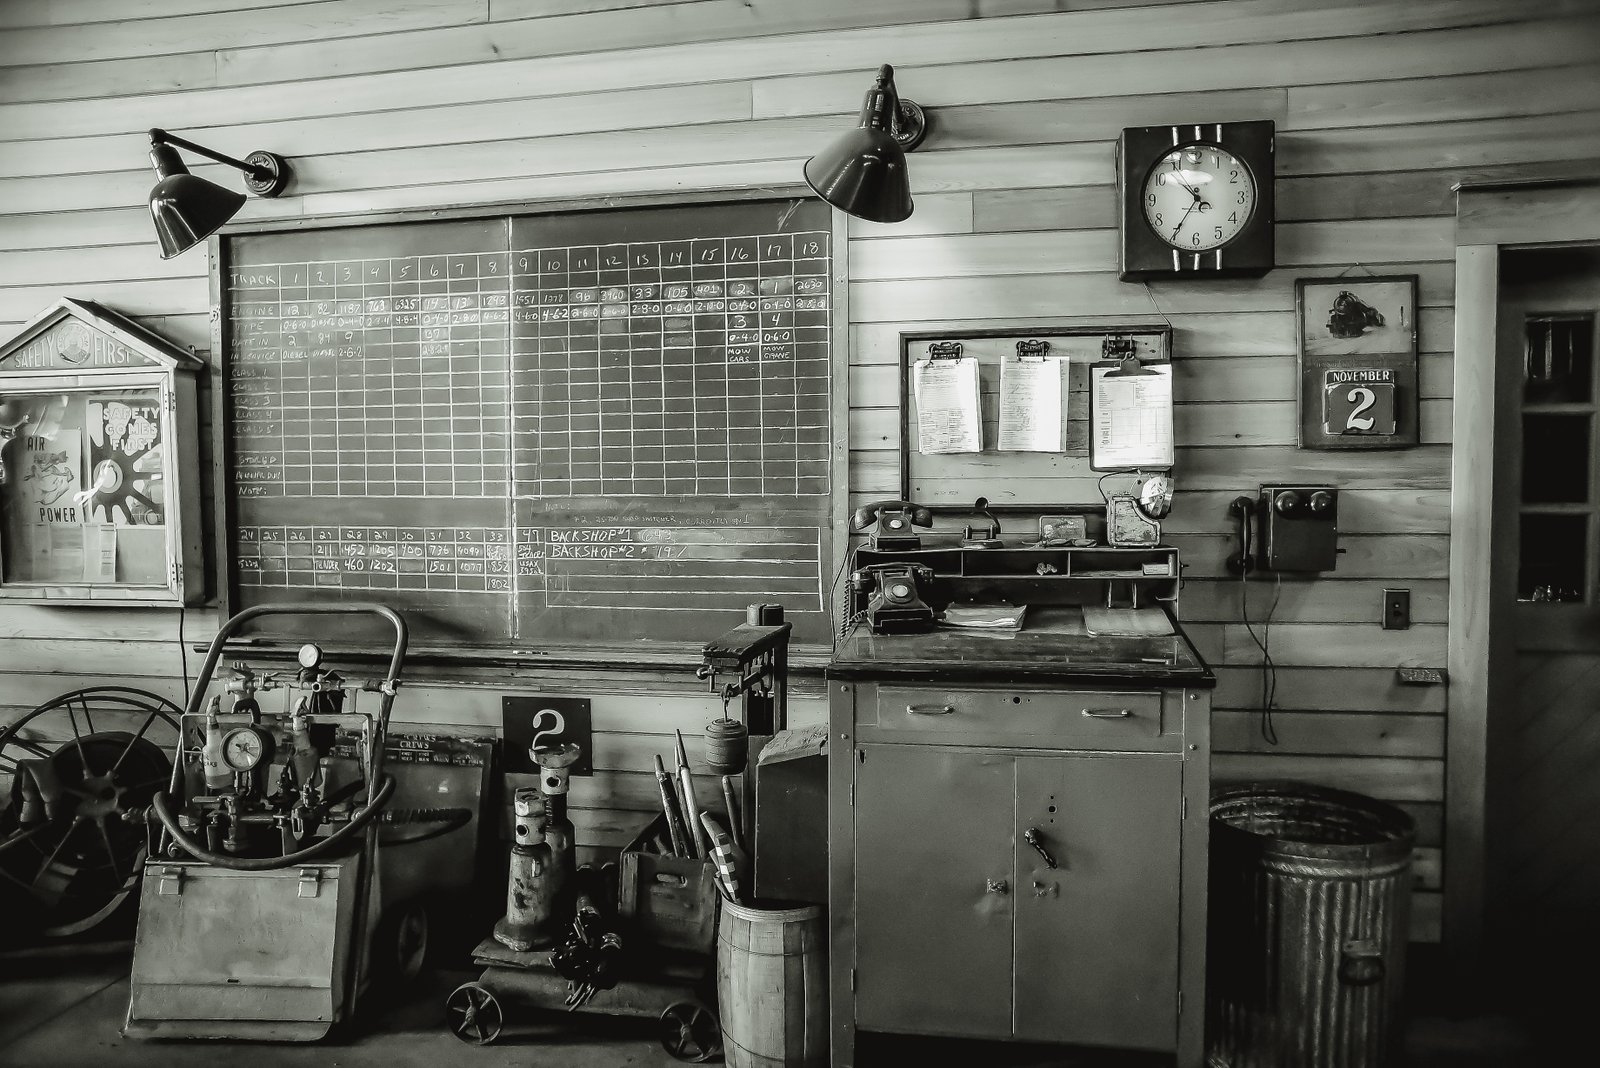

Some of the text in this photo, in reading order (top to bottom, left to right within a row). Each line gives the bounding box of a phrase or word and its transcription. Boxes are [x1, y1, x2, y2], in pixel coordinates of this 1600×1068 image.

[1215, 156, 1220, 169] 1
[1155, 173, 1167, 187] 10
[1229, 170, 1239, 184] 2
[1148, 193, 1157, 207] 9
[1237, 190, 1246, 205] 3
[1154, 213, 1164, 227] 8
[1228, 211, 1238, 225] 4
[1172, 227, 1182, 241] 7
[1192, 232, 1201, 246] 6
[1214, 226, 1223, 240] 5
[230, 273, 276, 286] TRACK
[294, 272, 298, 284] 1
[343, 267, 352, 282] 3
[370, 267, 380, 278] 4
[400, 265, 412, 278] 5
[430, 263, 439, 277] 6
[455, 263, 465, 275] 7
[488, 261, 497, 274] 8
[519, 257, 528, 272] 9
[547, 260, 561, 271] 10
[578, 258, 588, 269] 11
[606, 255, 623, 266] 12
[669, 251, 683, 263] 14
[701, 247, 719, 261] 15
[730, 247, 749, 261] 16
[767, 244, 782, 257] 17
[803, 241, 819, 255] 18
[395, 299, 417, 311] 6325
[635, 287, 652, 299] 33
[667, 286, 689, 299] 105
[734, 283, 747, 295] 2
[631, 303, 660, 314] 2-8-0
[344, 331, 354, 343] 9
[733, 315, 747, 329] 3
[771, 312, 781, 326] 4
[14, 332, 131, 368] SAFETY FIRST
[1333, 370, 1391, 382] NOVEMBER
[263, 395, 271, 406] 3
[103, 407, 160, 421] SAFETY
[1346, 387, 1377, 431] 2
[105, 422, 158, 436] COMES
[27, 436, 46, 451] AIR
[111, 437, 154, 451] FIRST
[39, 506, 77, 523] POWER
[263, 531, 279, 541] 25
[290, 531, 306, 540] 26
[346, 530, 362, 540] 28
[374, 531, 388, 540] 29
[459, 530, 472, 540] 32
[490, 531, 503, 542] 33
[344, 544, 366, 556] 452
[344, 559, 364, 571] 460
[429, 560, 451, 573] 1501
